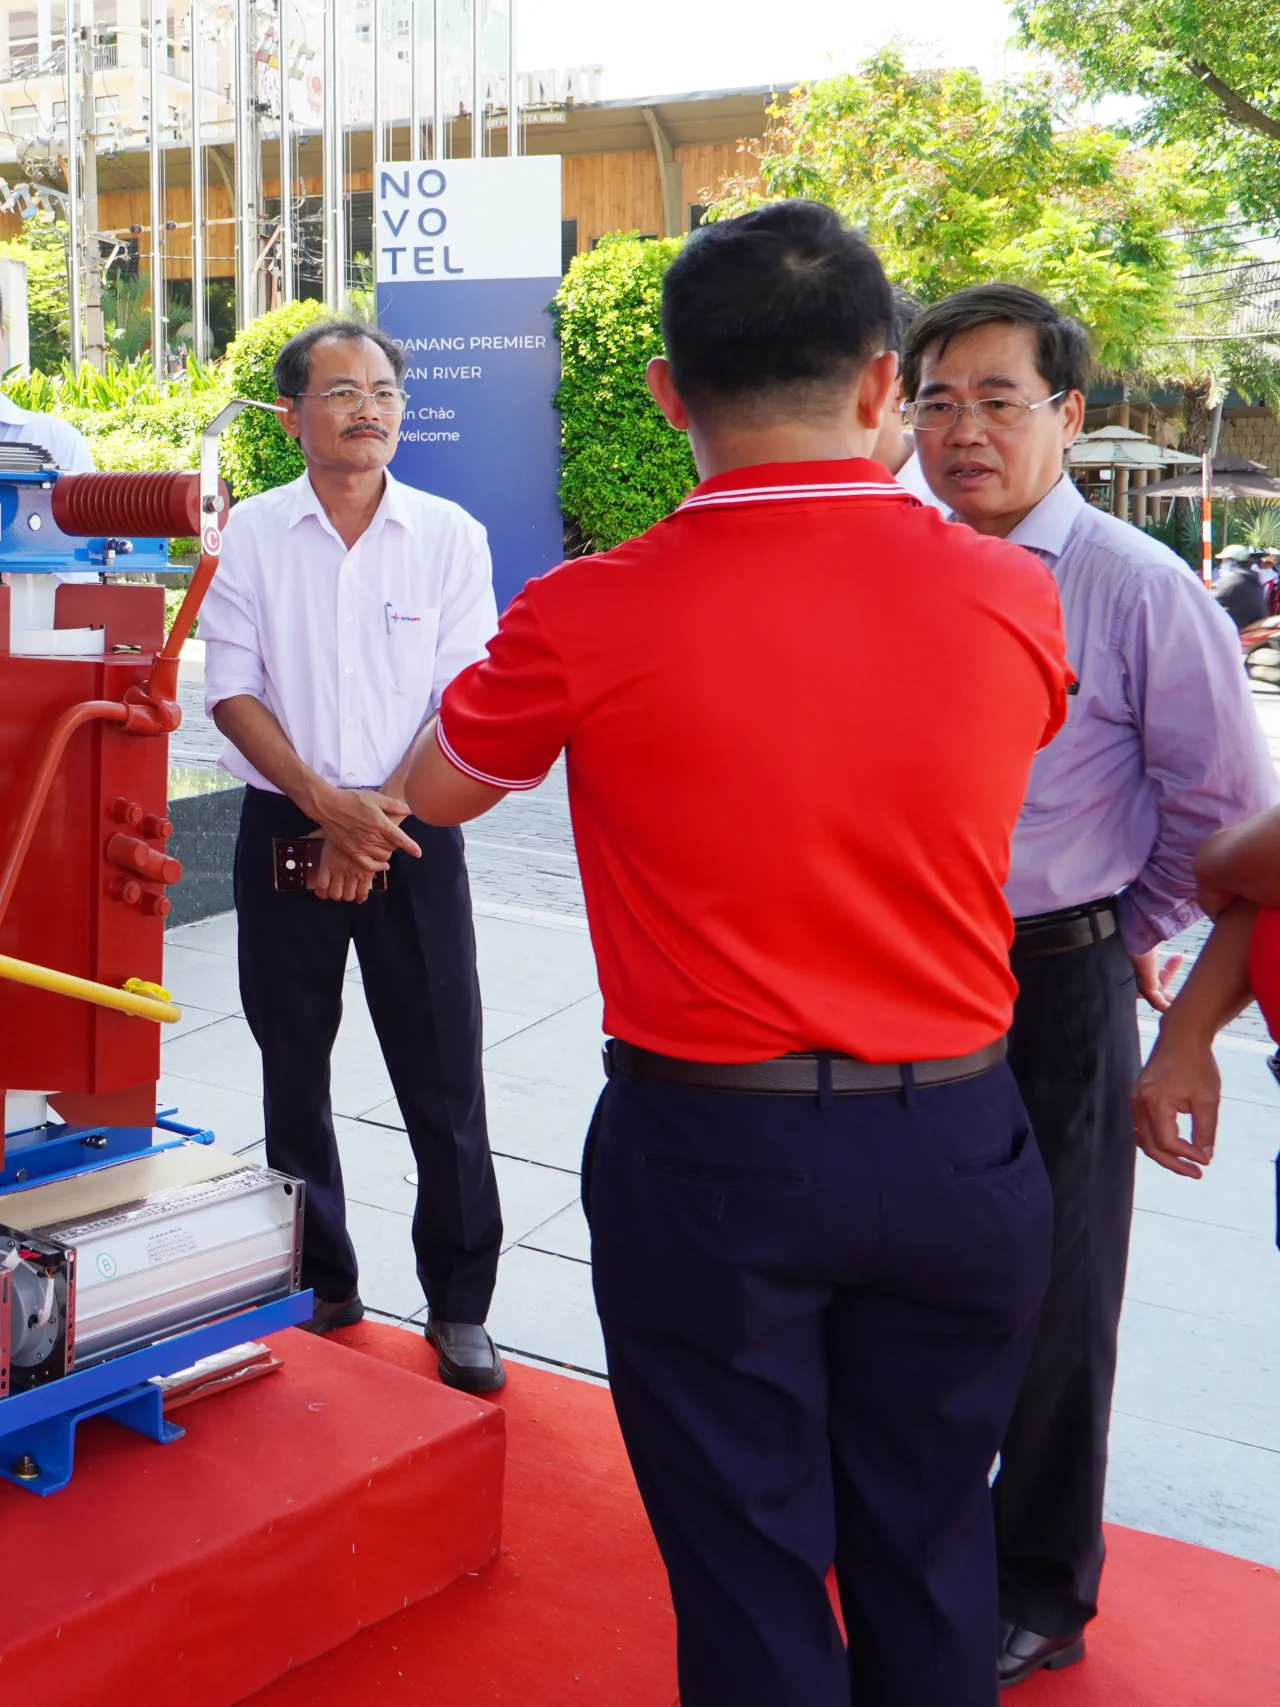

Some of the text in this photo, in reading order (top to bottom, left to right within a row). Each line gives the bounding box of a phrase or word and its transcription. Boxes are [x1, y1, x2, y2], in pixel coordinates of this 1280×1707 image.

[380, 168, 447, 200] NO
[381, 208, 448, 238] VO
[381, 245, 464, 276] TEL
[470, 335, 546, 350] PREMIER
[404, 366, 482, 380] AN RIVER
[403, 406, 455, 420] in Chào
[206, 530, 218, 549] C
[102, 1259, 112, 1271] B
